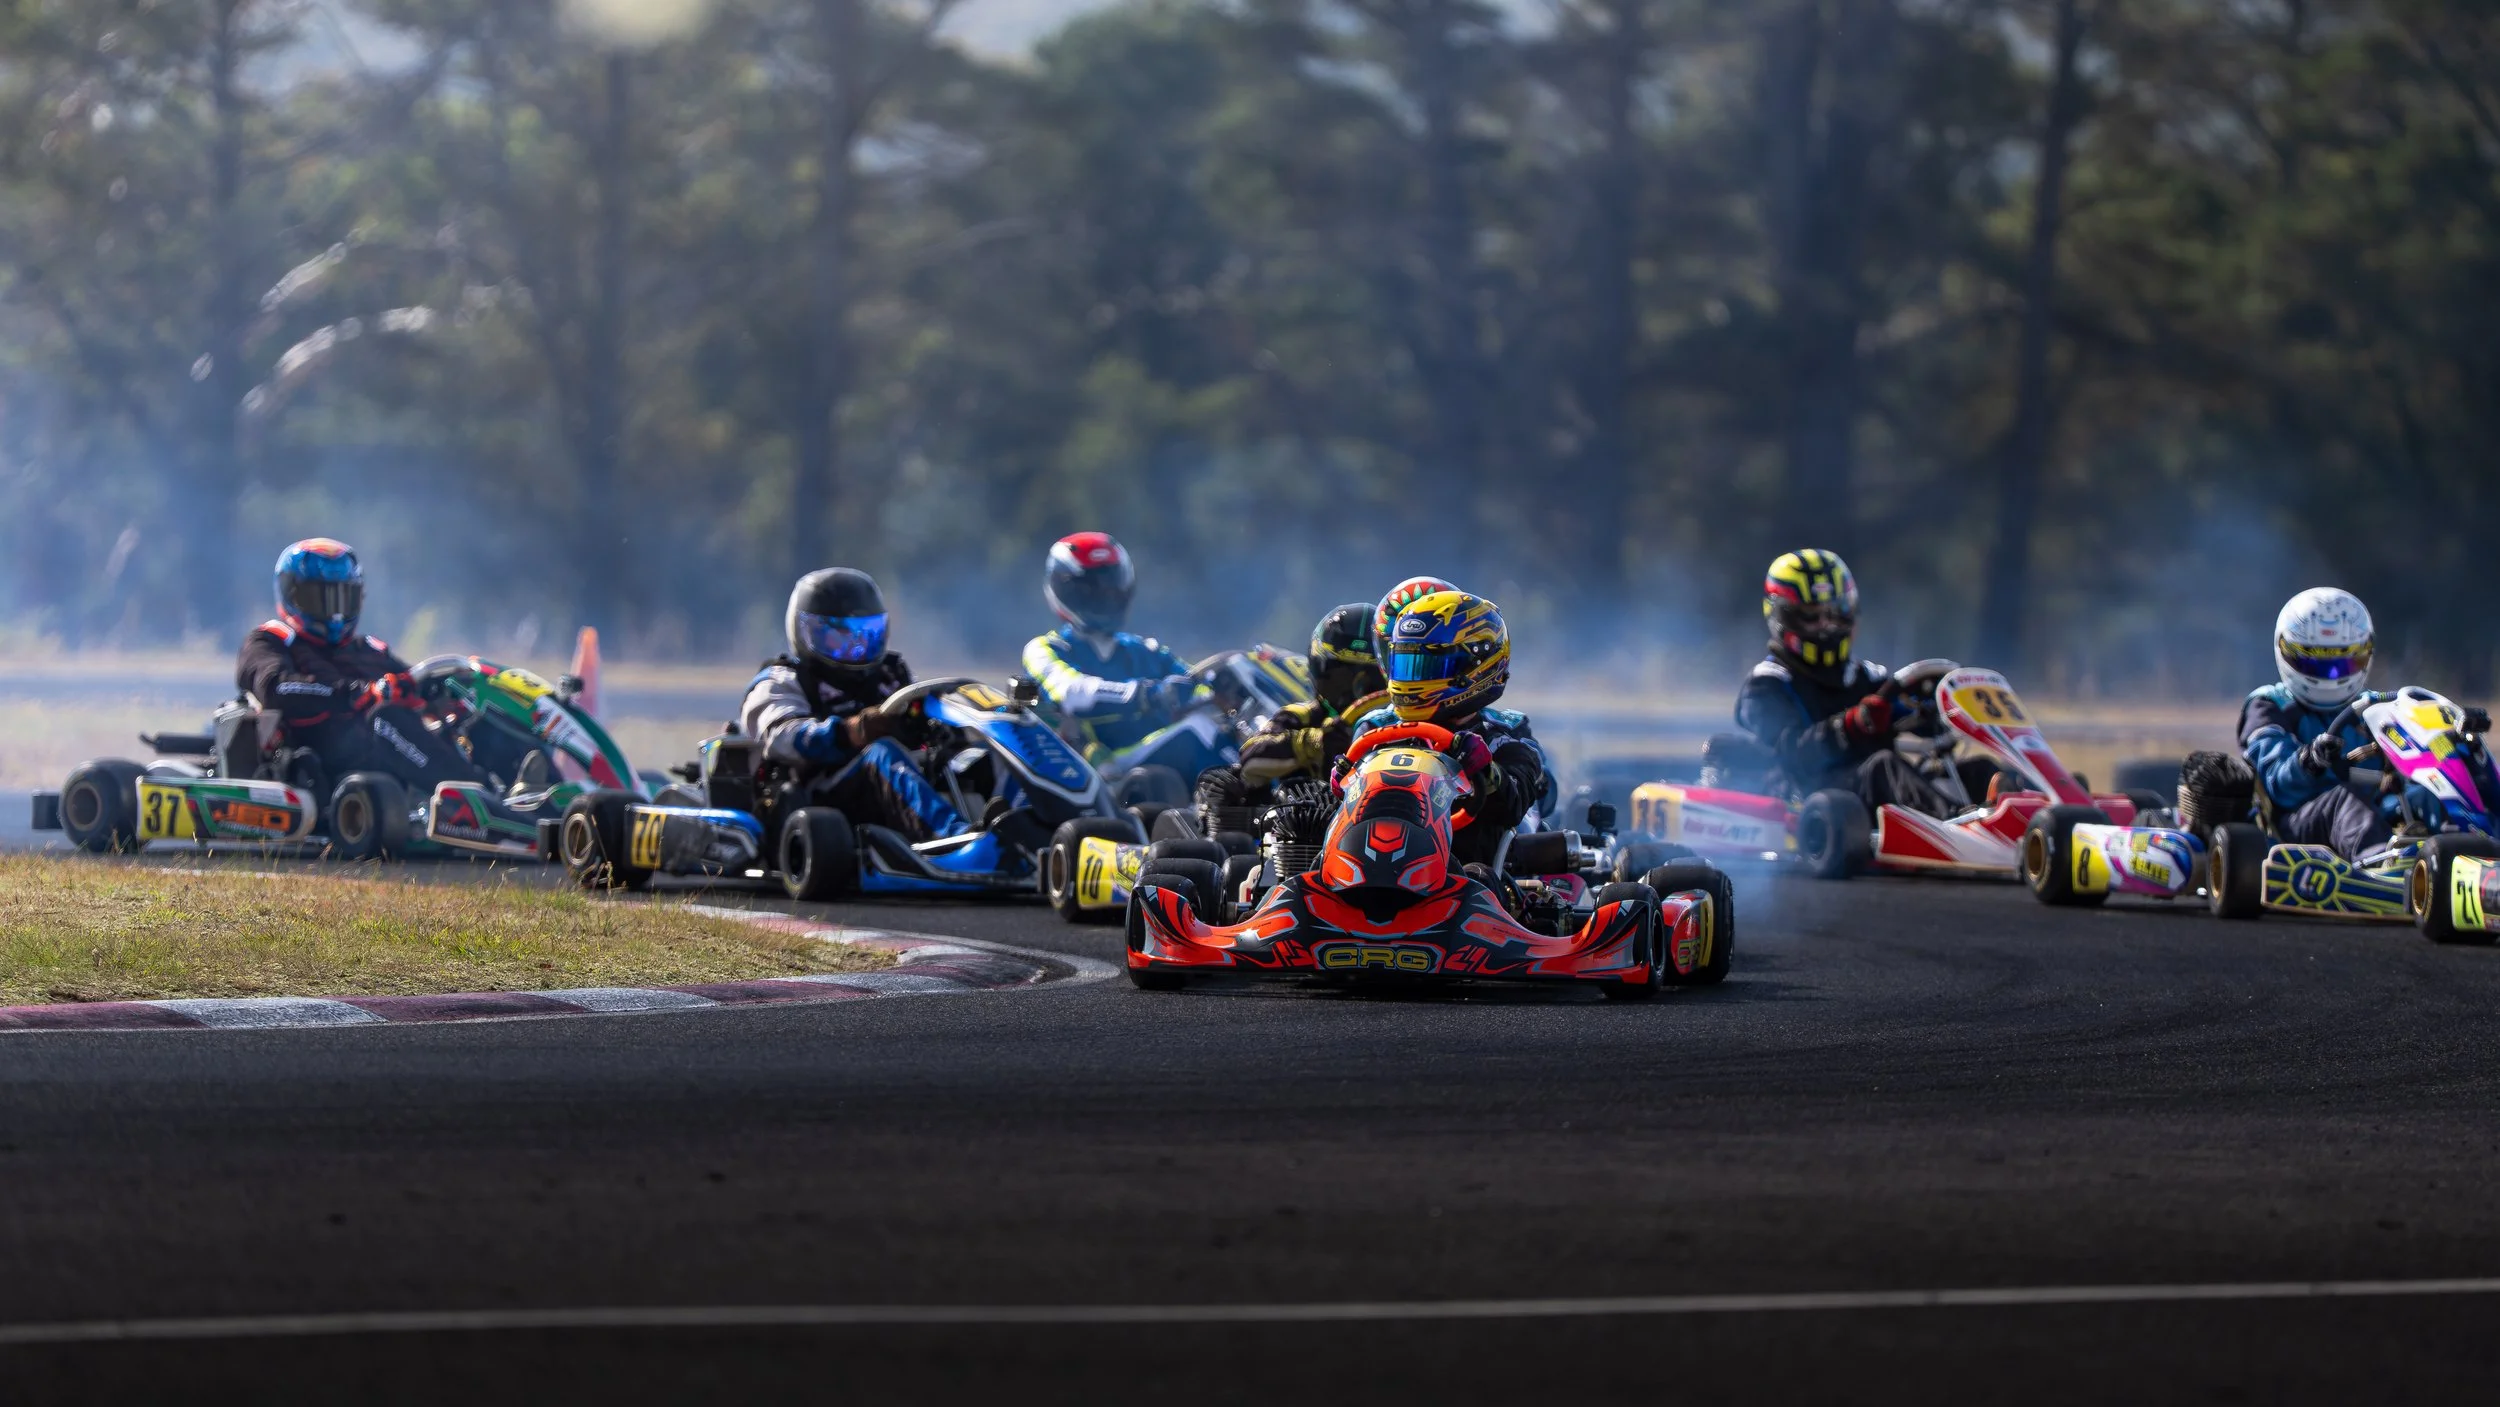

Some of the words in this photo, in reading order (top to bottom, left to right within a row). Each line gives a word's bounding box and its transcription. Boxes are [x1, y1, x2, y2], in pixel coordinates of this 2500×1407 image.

[1390, 753, 1416, 767] 6
[145, 791, 180, 836] 37
[1081, 855, 1104, 899] 10
[2078, 846, 2091, 887] 8
[1324, 946, 1431, 973] CRG
